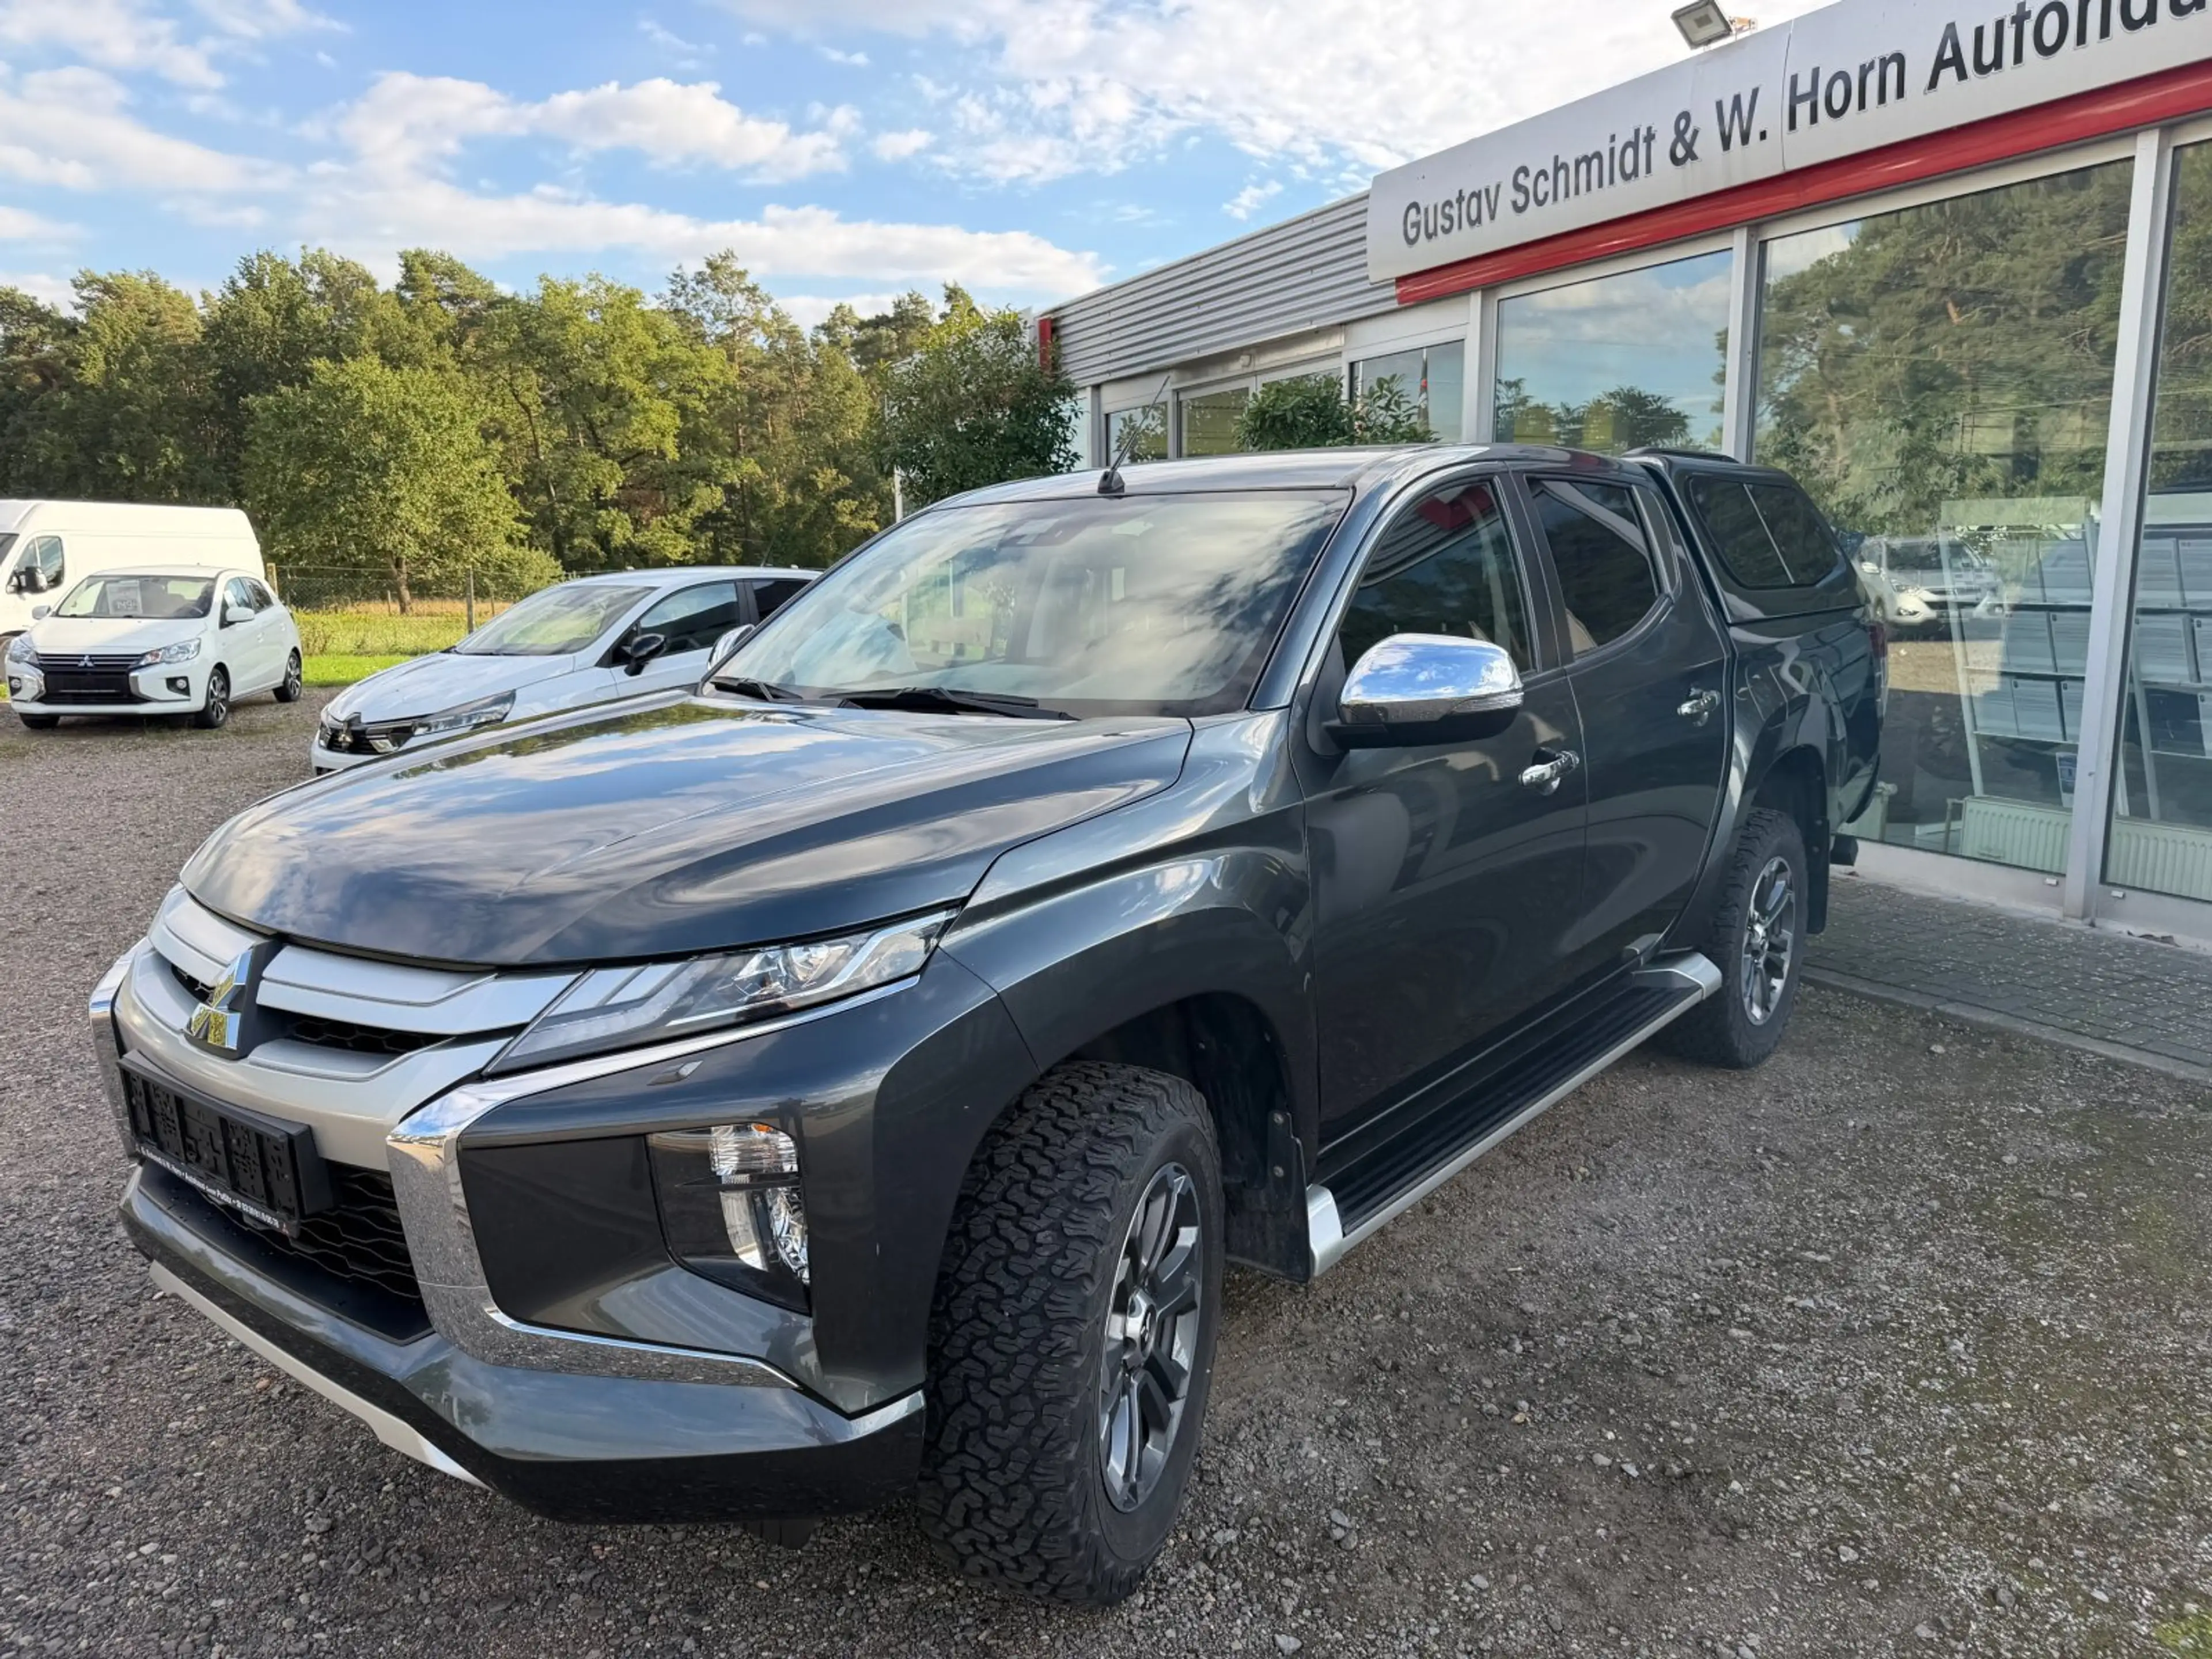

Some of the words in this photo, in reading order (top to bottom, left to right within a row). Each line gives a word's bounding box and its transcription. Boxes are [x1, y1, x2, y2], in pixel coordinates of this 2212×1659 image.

[1403, 181, 1501, 246] Gustav
[1512, 125, 1656, 214] Schmidt
[1670, 110, 1699, 167] &
[1715, 86, 1767, 152] W.
[1789, 52, 1906, 131] Horn
